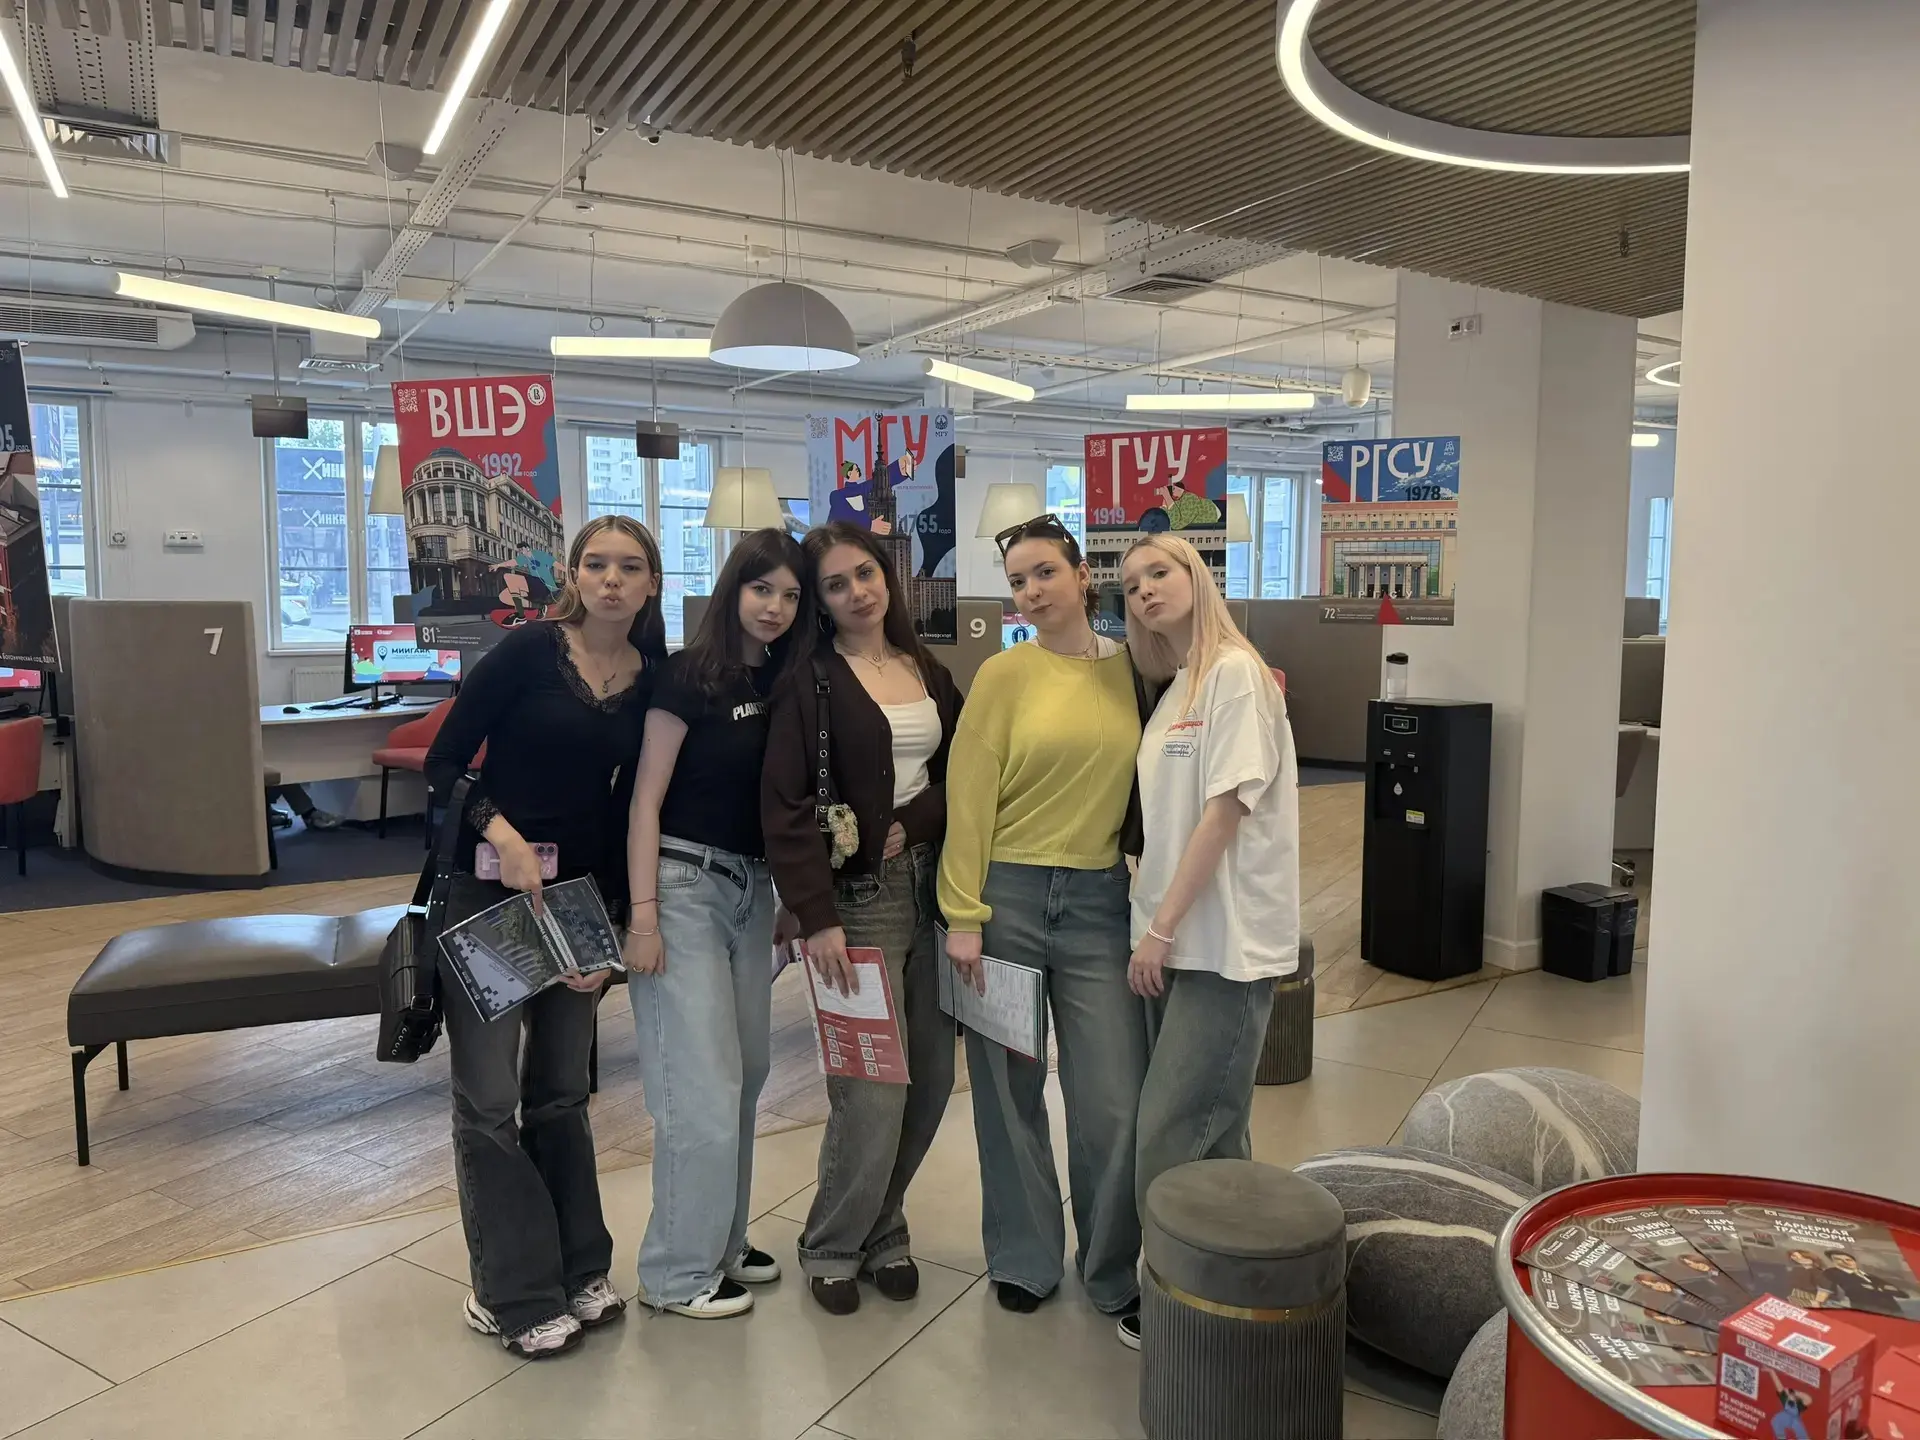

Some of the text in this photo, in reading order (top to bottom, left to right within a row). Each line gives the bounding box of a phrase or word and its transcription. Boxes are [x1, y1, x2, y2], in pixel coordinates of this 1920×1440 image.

[276, 398, 284, 407] 7
[427, 384, 526, 438] ВШЭ
[834, 414, 928, 490] МГУ
[482, 452, 523, 478] 1992
[1111, 434, 1191, 509] ГУУ
[1350, 442, 1434, 503] РГСУ
[1405, 485, 1441, 501] 1978
[901, 513, 938, 534] 1755
[1093, 507, 1126, 525] 1919
[970, 617, 987, 639] 9
[203, 626, 224, 656] 7
[1773, 1225, 1855, 1243] ТРАЕКТОРИЯ
[1775, 1219, 1849, 1237] КАРЬЕРНАЯ
